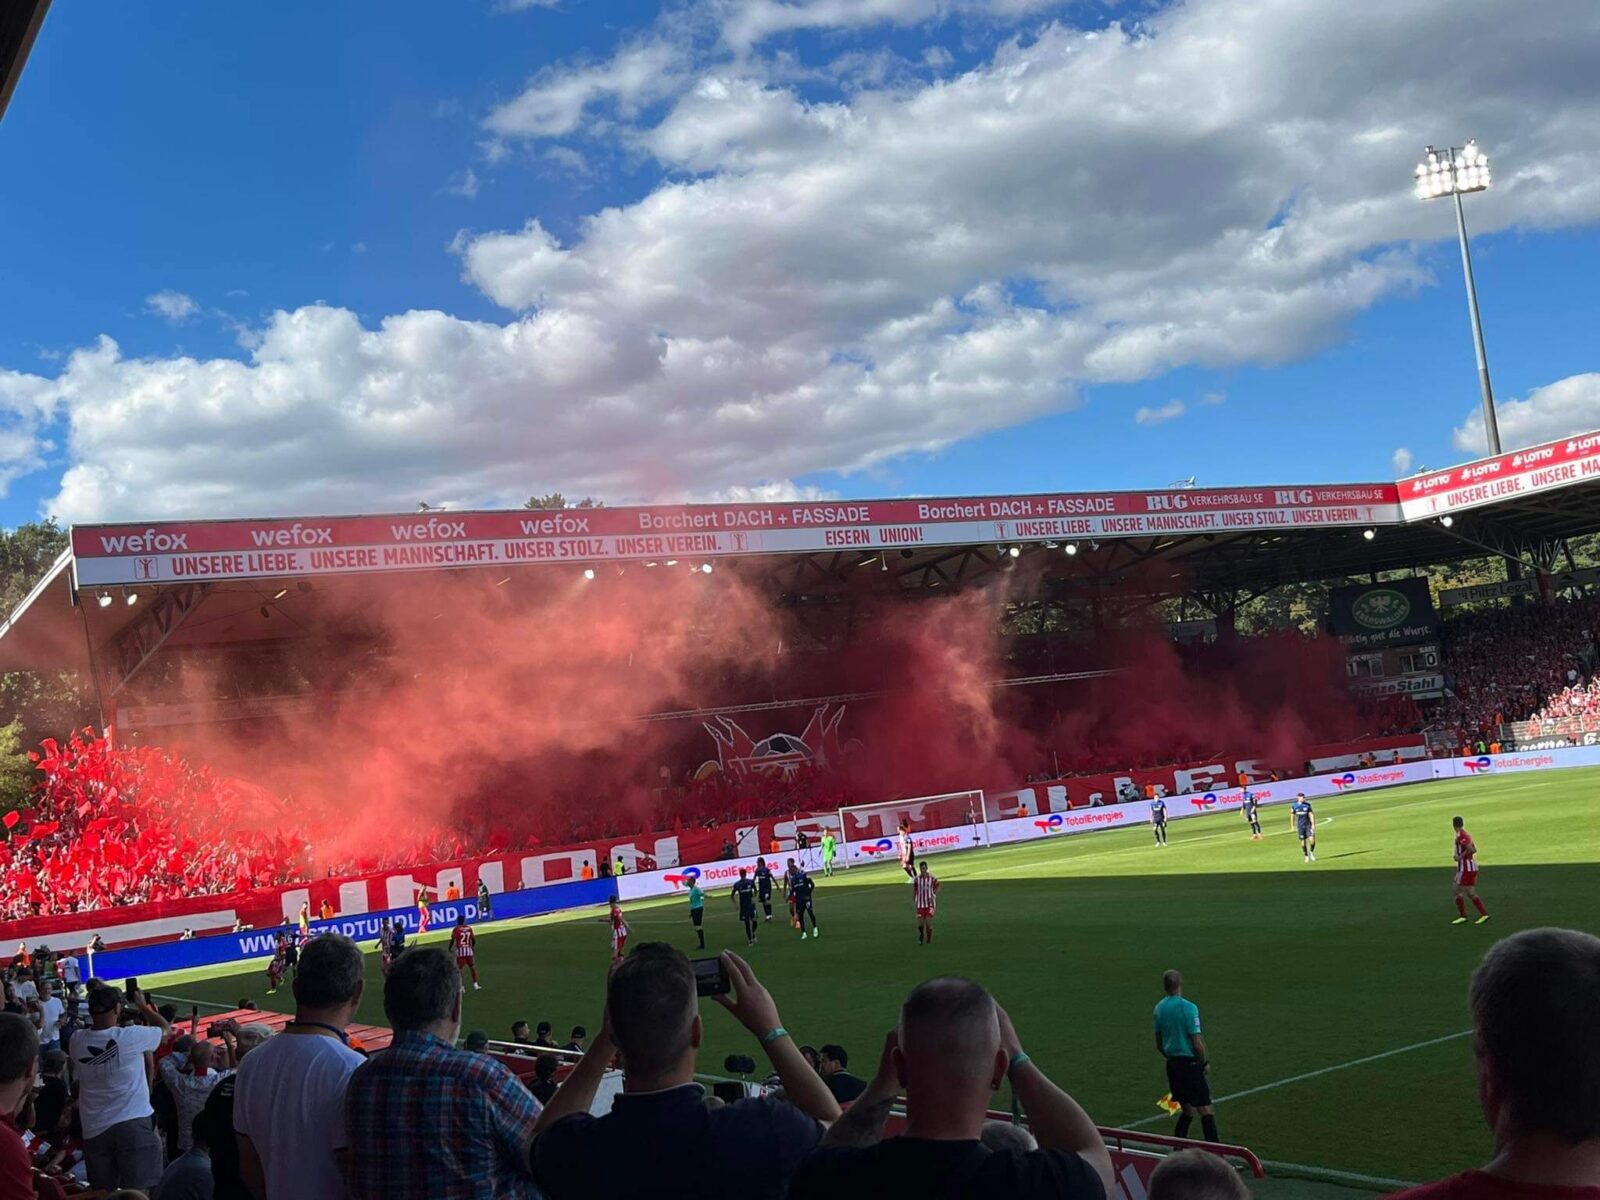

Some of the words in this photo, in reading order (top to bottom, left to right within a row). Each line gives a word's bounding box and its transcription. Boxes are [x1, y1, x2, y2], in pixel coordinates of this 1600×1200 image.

[1523, 448, 1553, 463] LOTTO
[1472, 462, 1500, 478] LOTTO
[1423, 475, 1450, 489] LOTTO
[1447, 487, 1489, 507] UNSERE
[1490, 477, 1525, 496] LIEBE.
[1531, 466, 1577, 487] UNSERE
[1190, 493, 1250, 507] VERKEHRSBAU
[1253, 493, 1263, 504] SE
[1315, 489, 1372, 501] VERKEHRSBAU
[1374, 488, 1383, 500] SE
[639, 510, 718, 529] Borchert
[724, 509, 772, 527] DACH
[778, 513, 787, 524] +
[792, 506, 870, 525] FASSADE
[918, 502, 987, 520] Borchert
[990, 500, 1032, 516] DACH
[1036, 503, 1045, 514] +
[1048, 497, 1115, 514] FASSADE
[391, 518, 465, 542] wefox
[520, 513, 590, 535] wefox
[1015, 520, 1059, 537] UNSERE
[1061, 519, 1096, 535] LIEBE.
[1102, 517, 1143, 533] UNSERE
[1147, 512, 1218, 531] MANNSCHAFT.
[1222, 512, 1254, 526] UNSER
[1256, 510, 1289, 525] STOLZ.
[1293, 509, 1324, 523] UNSER
[1325, 507, 1361, 522] VEREIN.
[101, 528, 189, 553] wefox
[251, 523, 333, 547] wefox
[825, 528, 870, 546] EISERN
[879, 526, 924, 543] UNION!
[172, 553, 247, 577] UNSERE
[250, 551, 303, 573] LIEBE.
[310, 548, 377, 570] UNSERE
[383, 543, 499, 567] MANNSCHAFT.
[504, 541, 556, 560] UNSER
[560, 539, 608, 557] STOLZ.
[616, 537, 663, 556] UNSER
[665, 535, 721, 554] VEREIN.
[1470, 586, 1497, 600] Piltz
[1500, 580, 1533, 596] Legal
[1427, 654, 1436, 666] 0
[1494, 755, 1553, 768] TotalEnergies
[1356, 770, 1404, 785] TotalEnergies
[1065, 809, 1124, 827] TotalEnergies
[459, 931, 471, 945] 27
